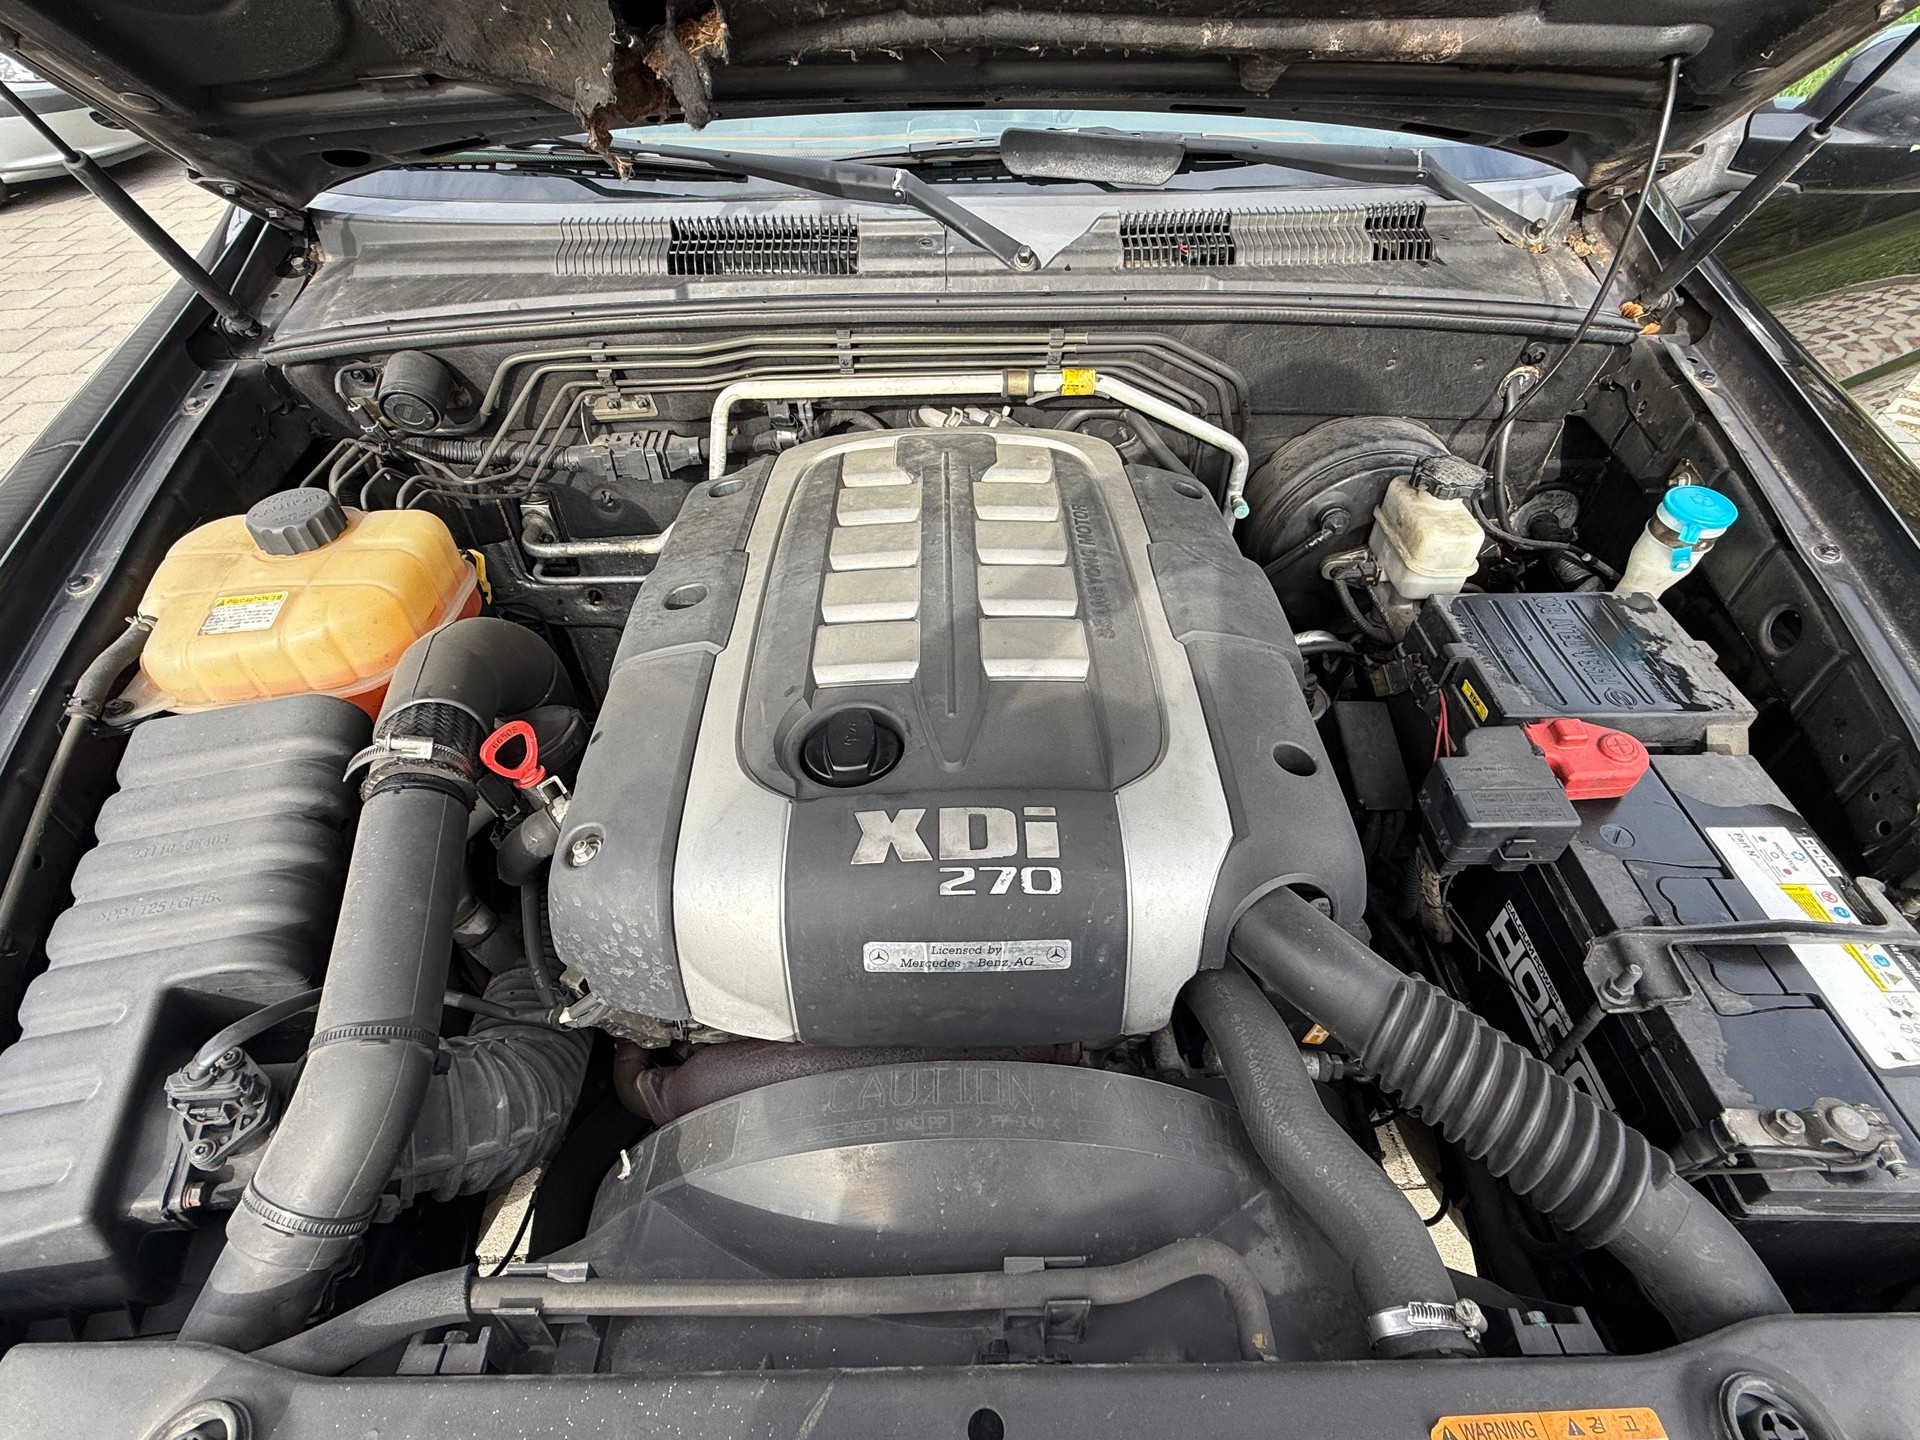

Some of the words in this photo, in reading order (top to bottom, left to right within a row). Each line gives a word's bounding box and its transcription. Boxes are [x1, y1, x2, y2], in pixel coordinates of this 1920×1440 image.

[1070, 504, 1096, 547] MOTOR
[1577, 660, 1622, 685] FUSE
[850, 807, 1060, 865] XDi
[1773, 841, 1800, 872] INDICATOR
[939, 866, 1063, 896] 270
[900, 957, 961, 968] Mercedes
[976, 957, 1009, 967] Benz
[1013, 957, 1034, 967] AG
[931, 945, 982, 955] Licensed
[987, 945, 1002, 958] by
[1505, 902, 1535, 958] CALCIUM
[1533, 955, 1560, 1004] POWER
[827, 1066, 1037, 1114] CAUTION
[1458, 1419, 1538, 1440] WARNING
